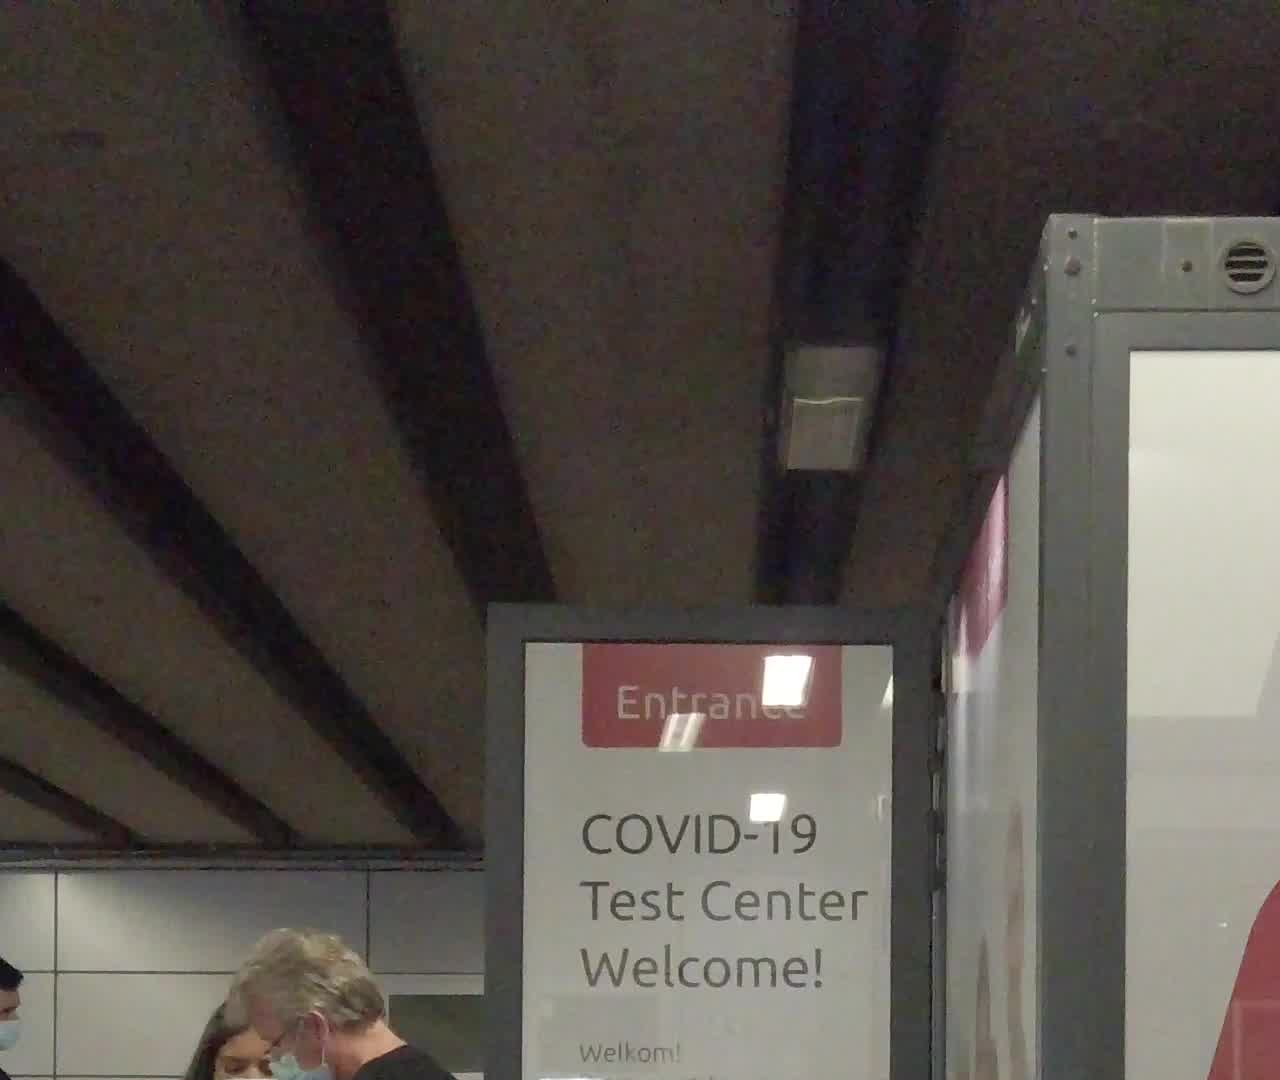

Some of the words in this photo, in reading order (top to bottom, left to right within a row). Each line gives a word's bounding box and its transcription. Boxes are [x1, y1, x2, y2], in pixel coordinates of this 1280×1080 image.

[617, 685, 806, 720] Entrance
[582, 813, 817, 856] COVID-19
[580, 881, 686, 922] Test
[701, 881, 869, 922] Center
[580, 944, 824, 989] Welcome!
[578, 1040, 681, 1064] Welkom!
